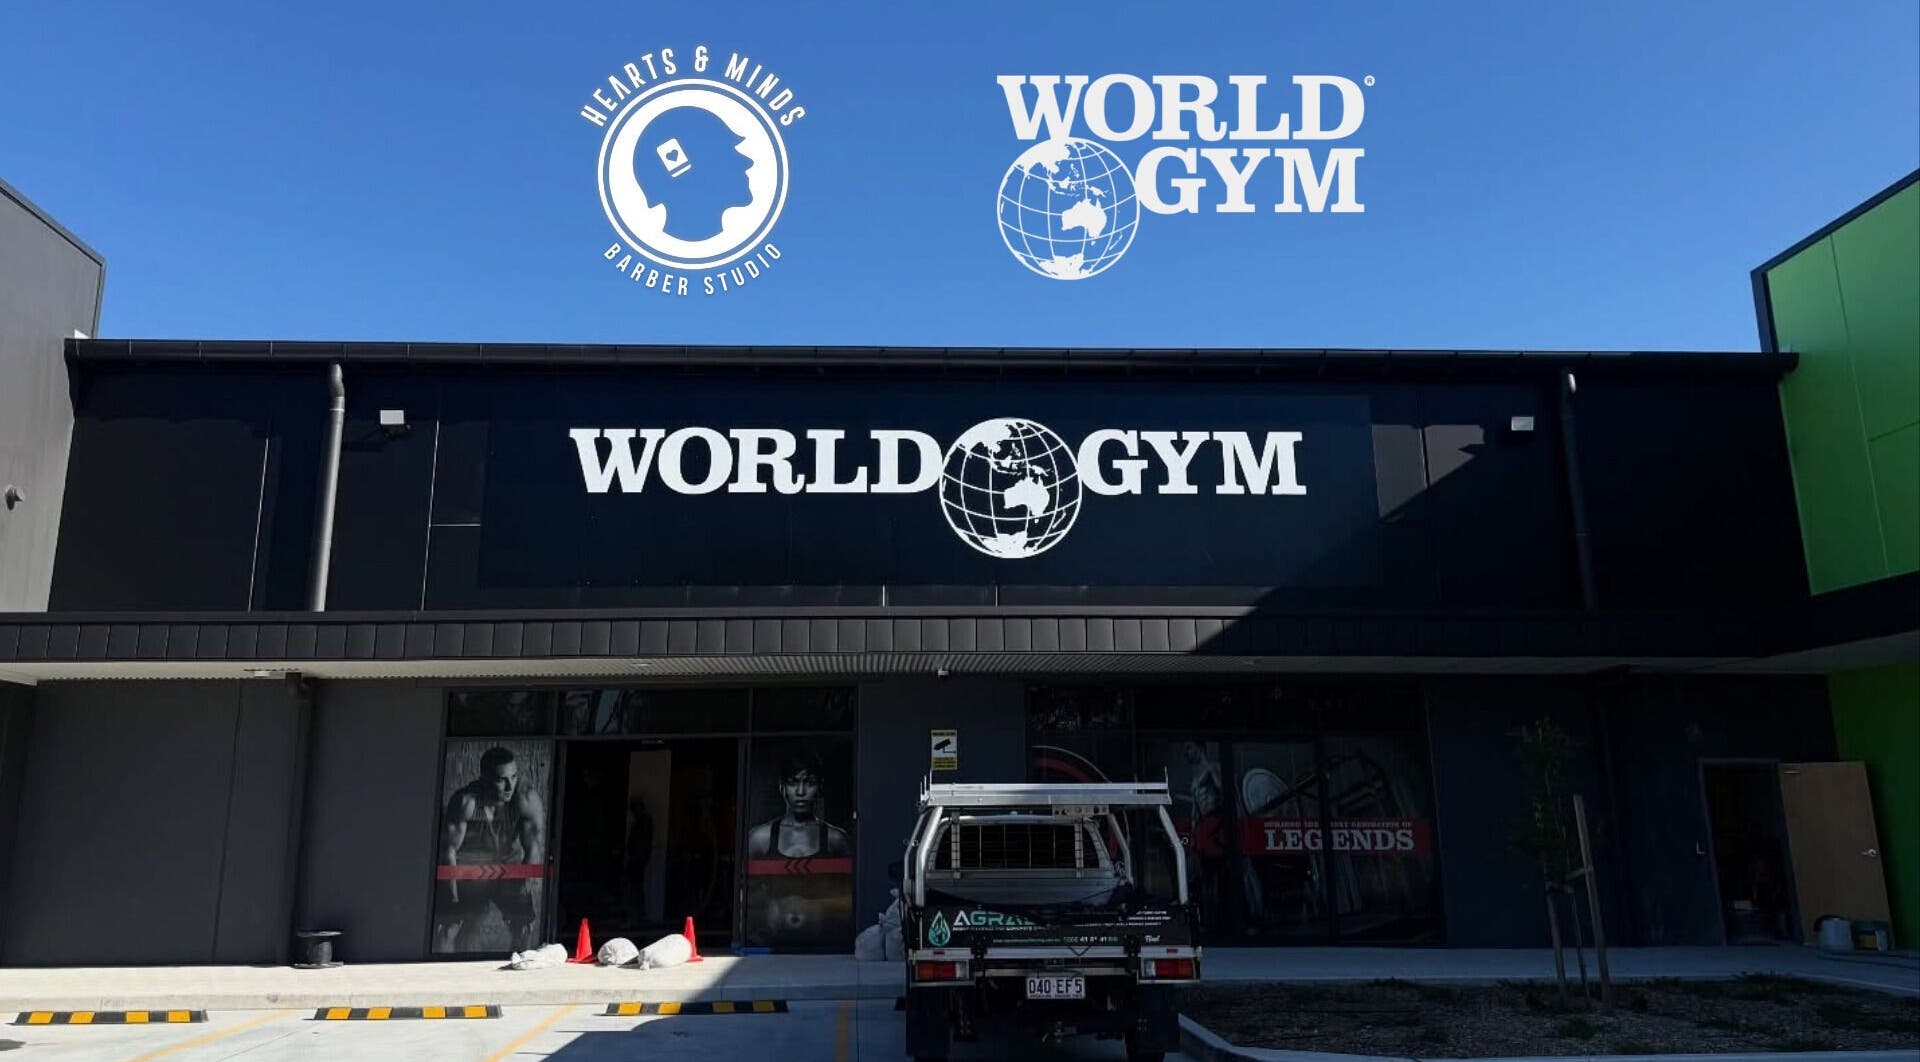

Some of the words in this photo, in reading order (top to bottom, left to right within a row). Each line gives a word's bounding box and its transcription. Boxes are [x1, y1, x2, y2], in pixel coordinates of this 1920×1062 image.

[569, 427, 943, 494] WORLD
[1079, 428, 1307, 496] GYM
[1264, 829, 1415, 851] LEGENDS
